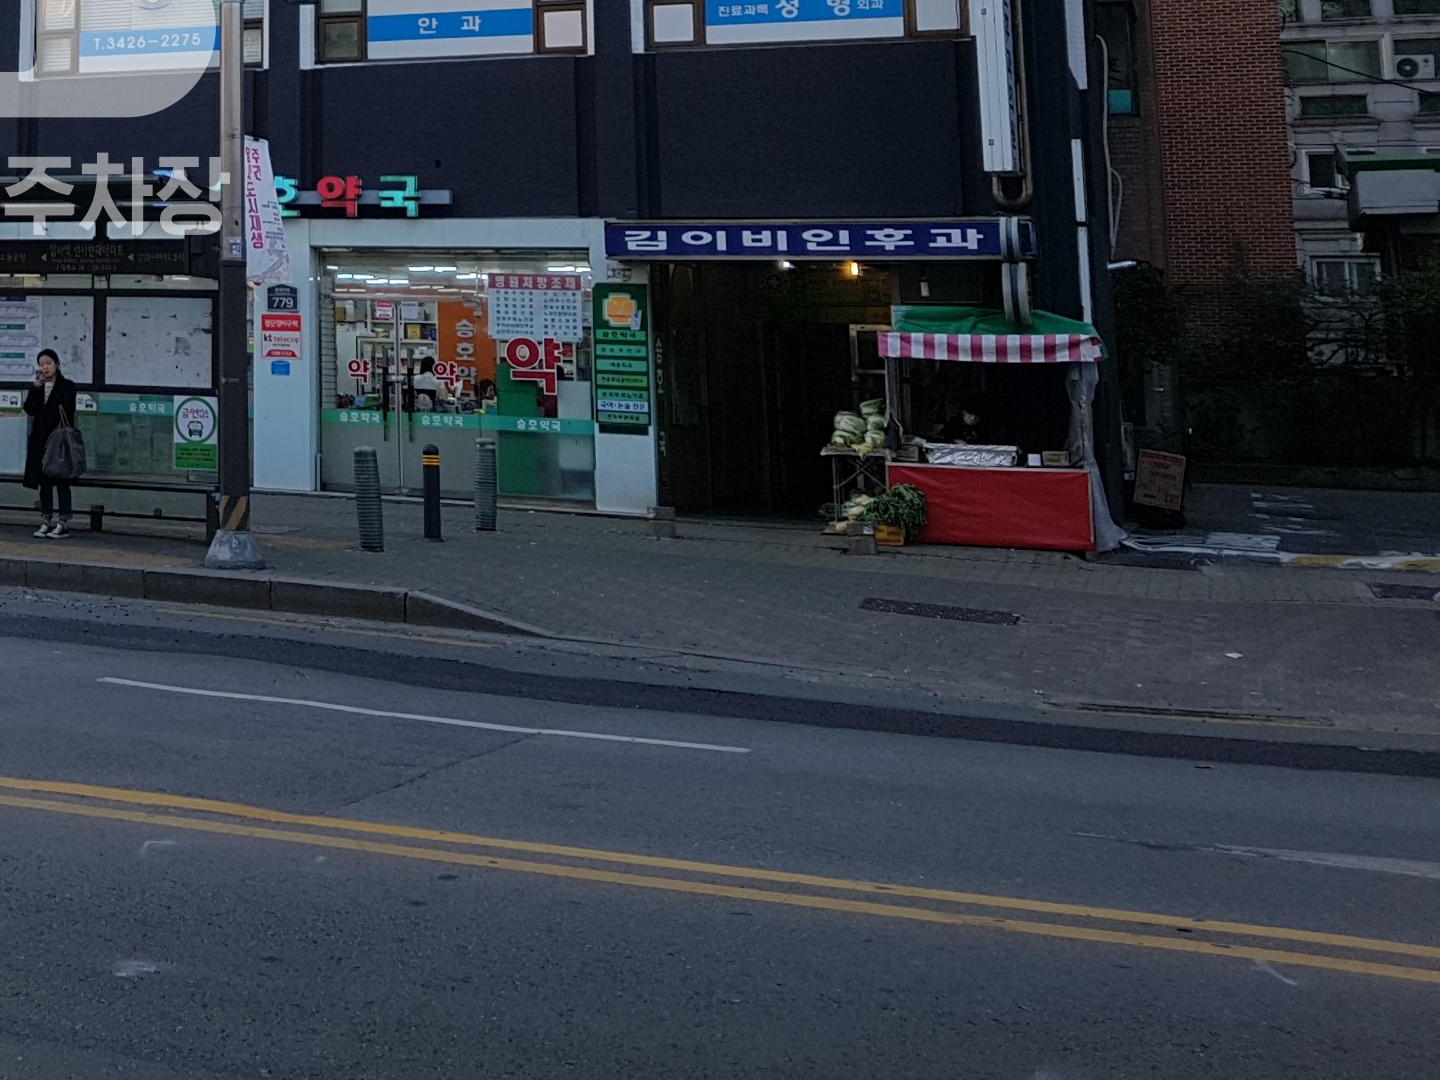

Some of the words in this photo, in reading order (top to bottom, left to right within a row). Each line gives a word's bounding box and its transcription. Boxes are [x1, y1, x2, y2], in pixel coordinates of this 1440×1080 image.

[93, 31, 202, 50] T.3426-2275
[272, 174, 420, 217] 호약국
[625, 227, 984, 252] 김이비인후과
[272, 296, 294, 309] 779
[348, 359, 370, 384] 약
[506, 337, 565, 396] 약
[339, 411, 380, 424] 승호약국
[421, 414, 464, 427] 승호약국
[517, 419, 561, 431] 승호약국
